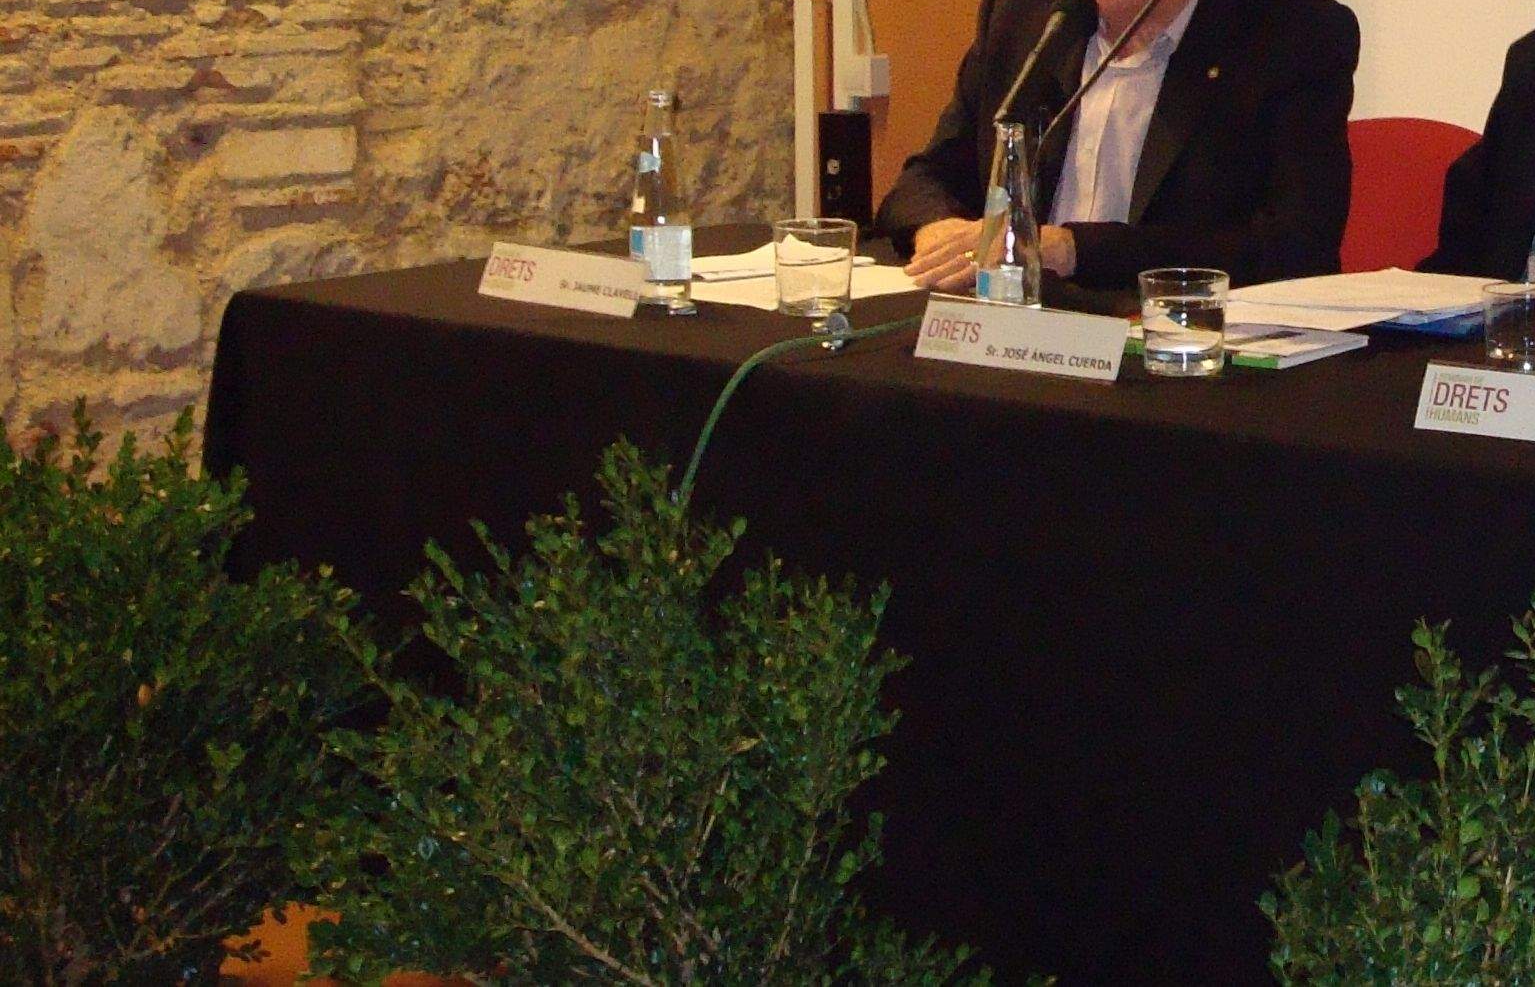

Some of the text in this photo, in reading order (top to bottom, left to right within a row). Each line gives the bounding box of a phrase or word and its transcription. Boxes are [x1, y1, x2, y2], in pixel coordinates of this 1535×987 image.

[489, 256, 537, 282] DRETS
[927, 317, 982, 344] DRETS
[985, 344, 999, 358] Sr.
[1002, 347, 1029, 362] JOSÉ
[1068, 356, 1112, 373] CUERDA
[1432, 382, 1510, 414] DRETS
